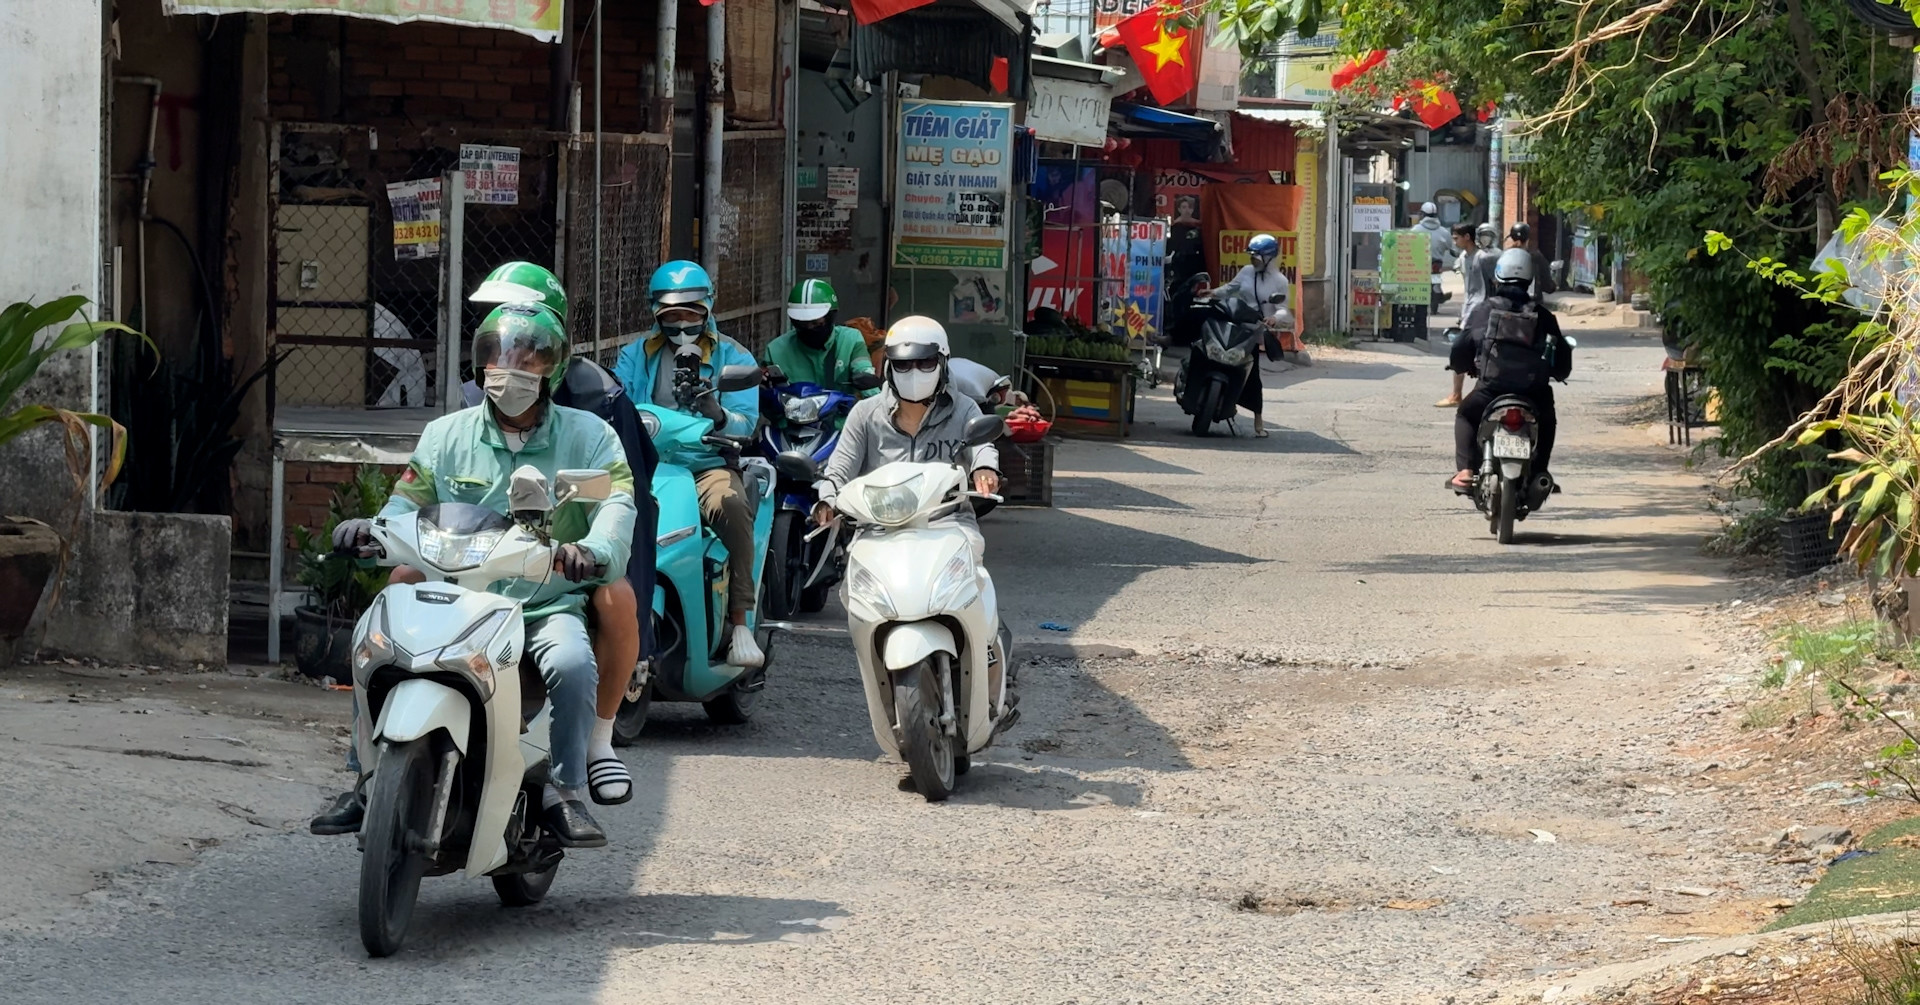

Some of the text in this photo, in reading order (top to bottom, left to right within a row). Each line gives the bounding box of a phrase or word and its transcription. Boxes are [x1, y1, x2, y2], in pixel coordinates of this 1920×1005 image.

[905, 111, 1003, 146] TIỆM GIẶT
[488, 151, 519, 162] INTERNET
[905, 145, 1001, 168] MẸ GẠO
[906, 169, 998, 189] GIẶT SẤY NHANH
[394, 227, 415, 241] 0328
[416, 226, 432, 238] 432
[923, 439, 959, 462] DIY
[418, 593, 452, 603] HONDA
[496, 660, 519, 673] HONDA
